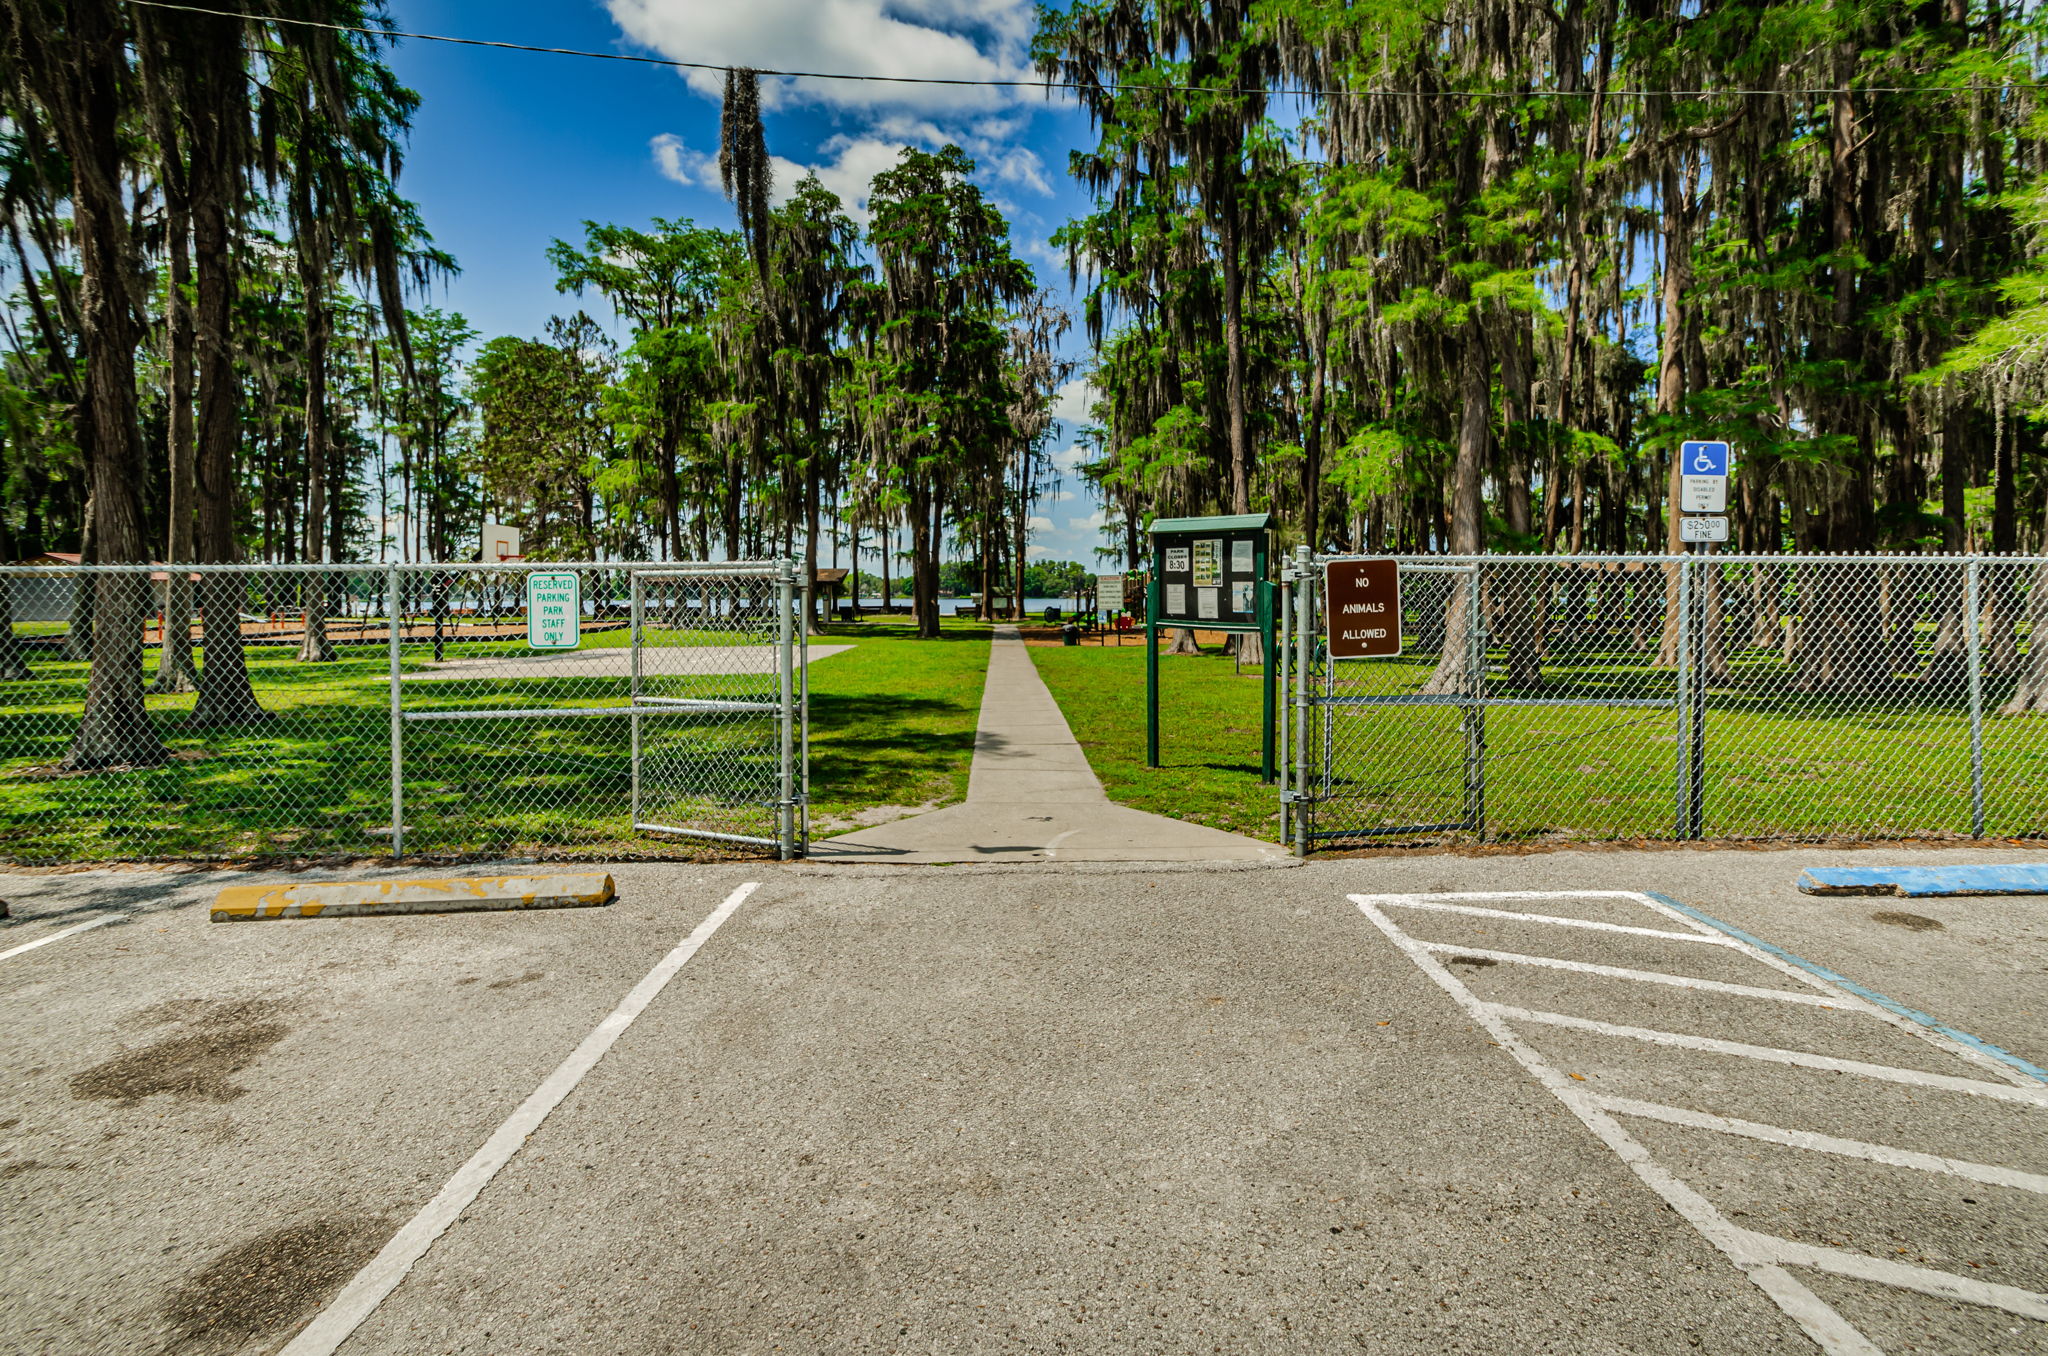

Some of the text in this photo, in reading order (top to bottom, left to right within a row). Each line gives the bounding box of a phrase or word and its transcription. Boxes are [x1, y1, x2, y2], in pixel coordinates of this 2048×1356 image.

[1695, 531, 1712, 539] FINE
[1170, 560, 1185, 570] 8:30
[533, 580, 573, 590] RESERVED
[1355, 577, 1370, 588] NO
[537, 593, 570, 602] PARKING
[543, 606, 564, 615] PARK
[1342, 602, 1385, 614] ANIMALS
[542, 618, 566, 628] STAFF
[544, 632, 564, 642] ONLY
[1342, 628, 1387, 640] ALLOWED
